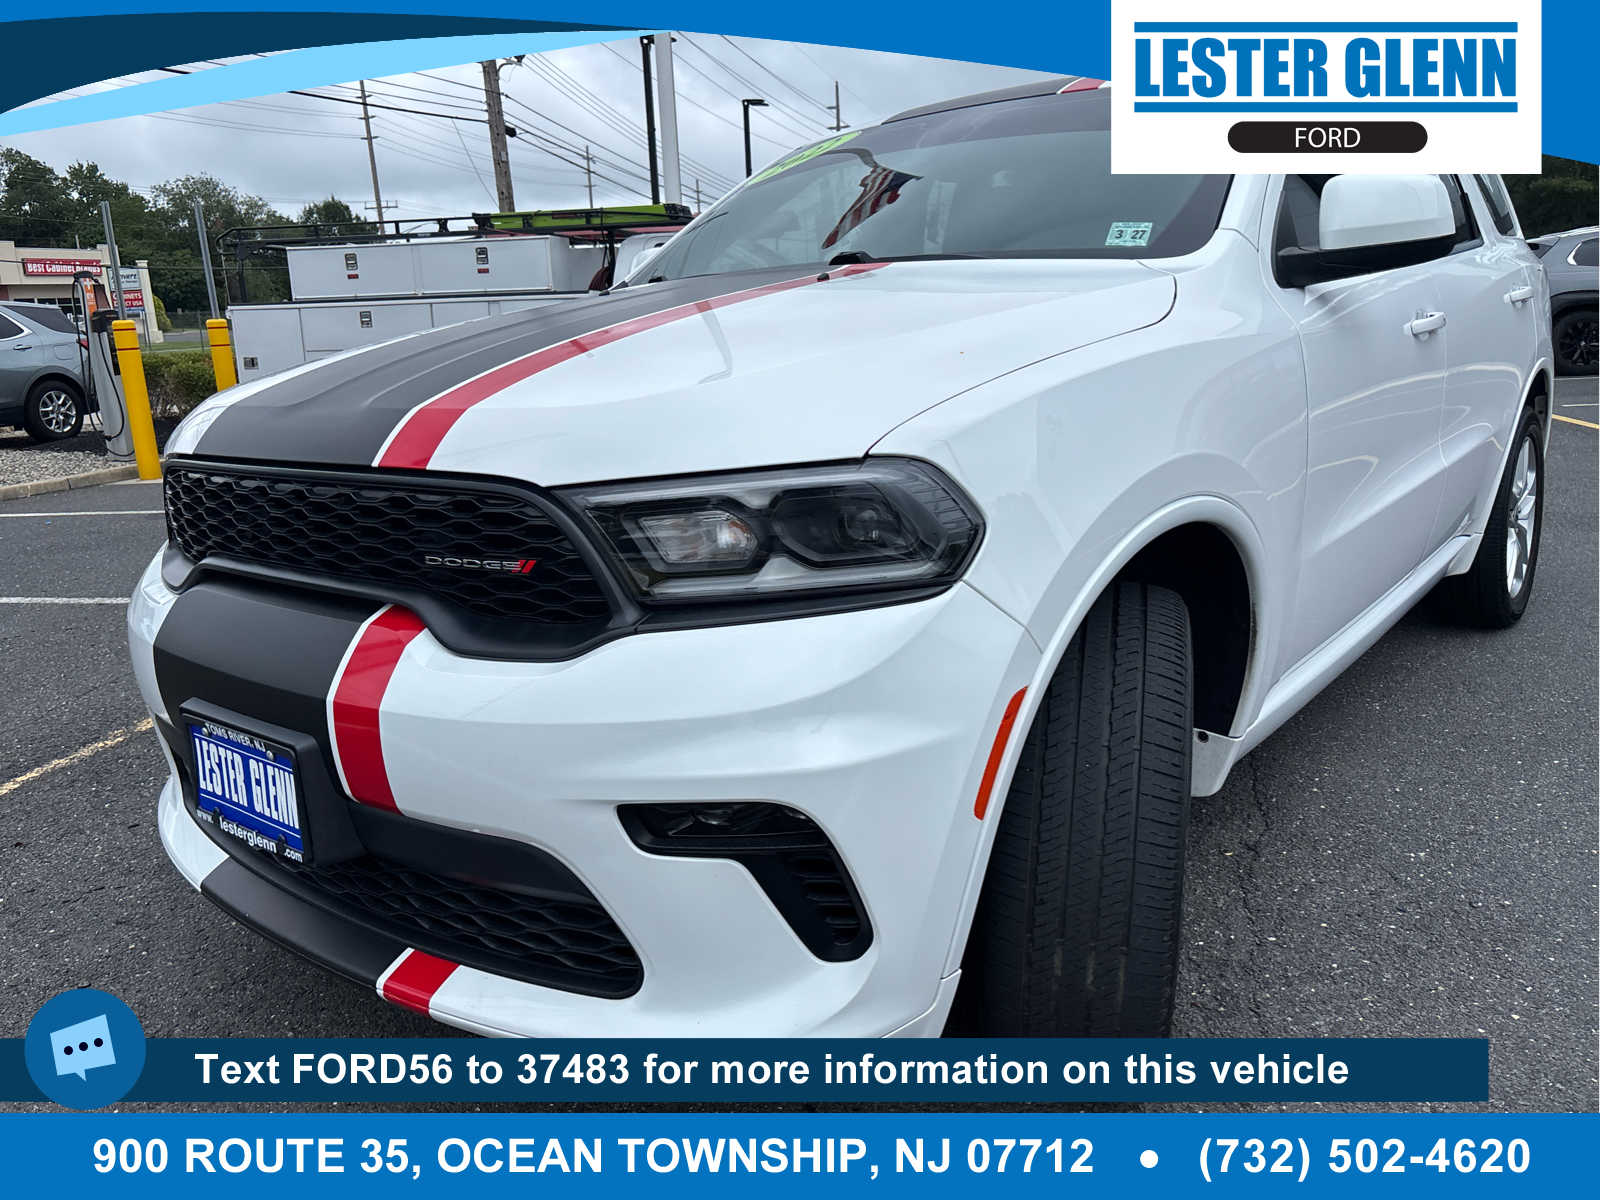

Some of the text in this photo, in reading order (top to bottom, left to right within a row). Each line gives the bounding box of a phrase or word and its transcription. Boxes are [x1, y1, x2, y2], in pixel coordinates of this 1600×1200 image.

[1115, 229, 1147, 240] 3 27
[424, 555, 521, 570] DODGE
[205, 722, 229, 740] TOMS
[254, 739, 266, 752] NJ
[195, 737, 300, 829] LESTER GLENN
